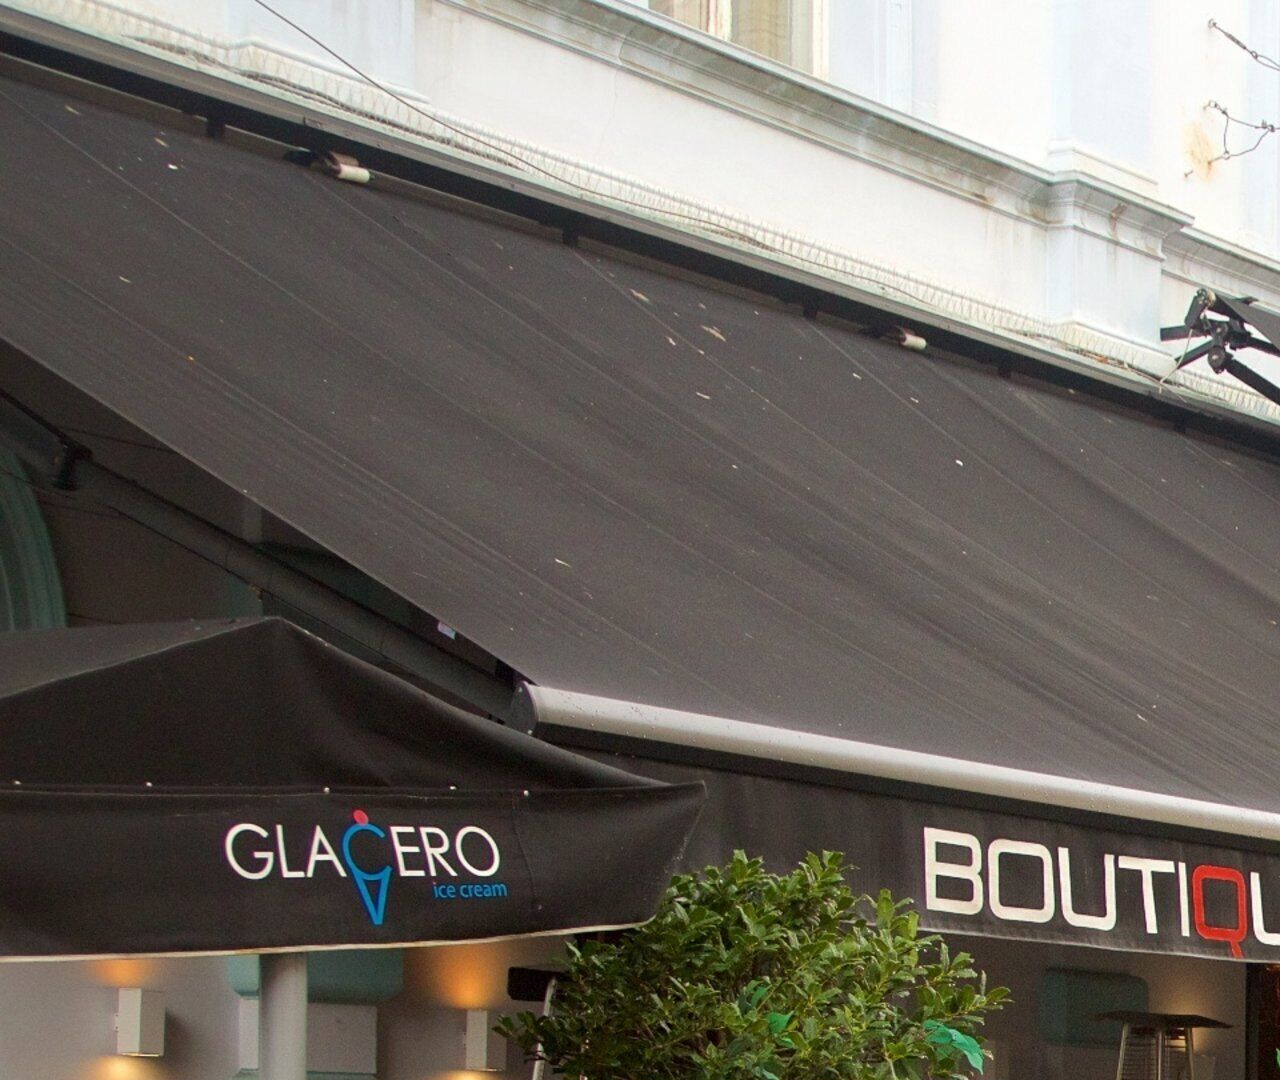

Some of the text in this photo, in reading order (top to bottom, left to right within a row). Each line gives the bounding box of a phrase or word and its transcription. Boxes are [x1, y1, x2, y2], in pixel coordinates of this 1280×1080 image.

[225, 815, 500, 900] GLACERO
[433, 882, 507, 898] ice cream
